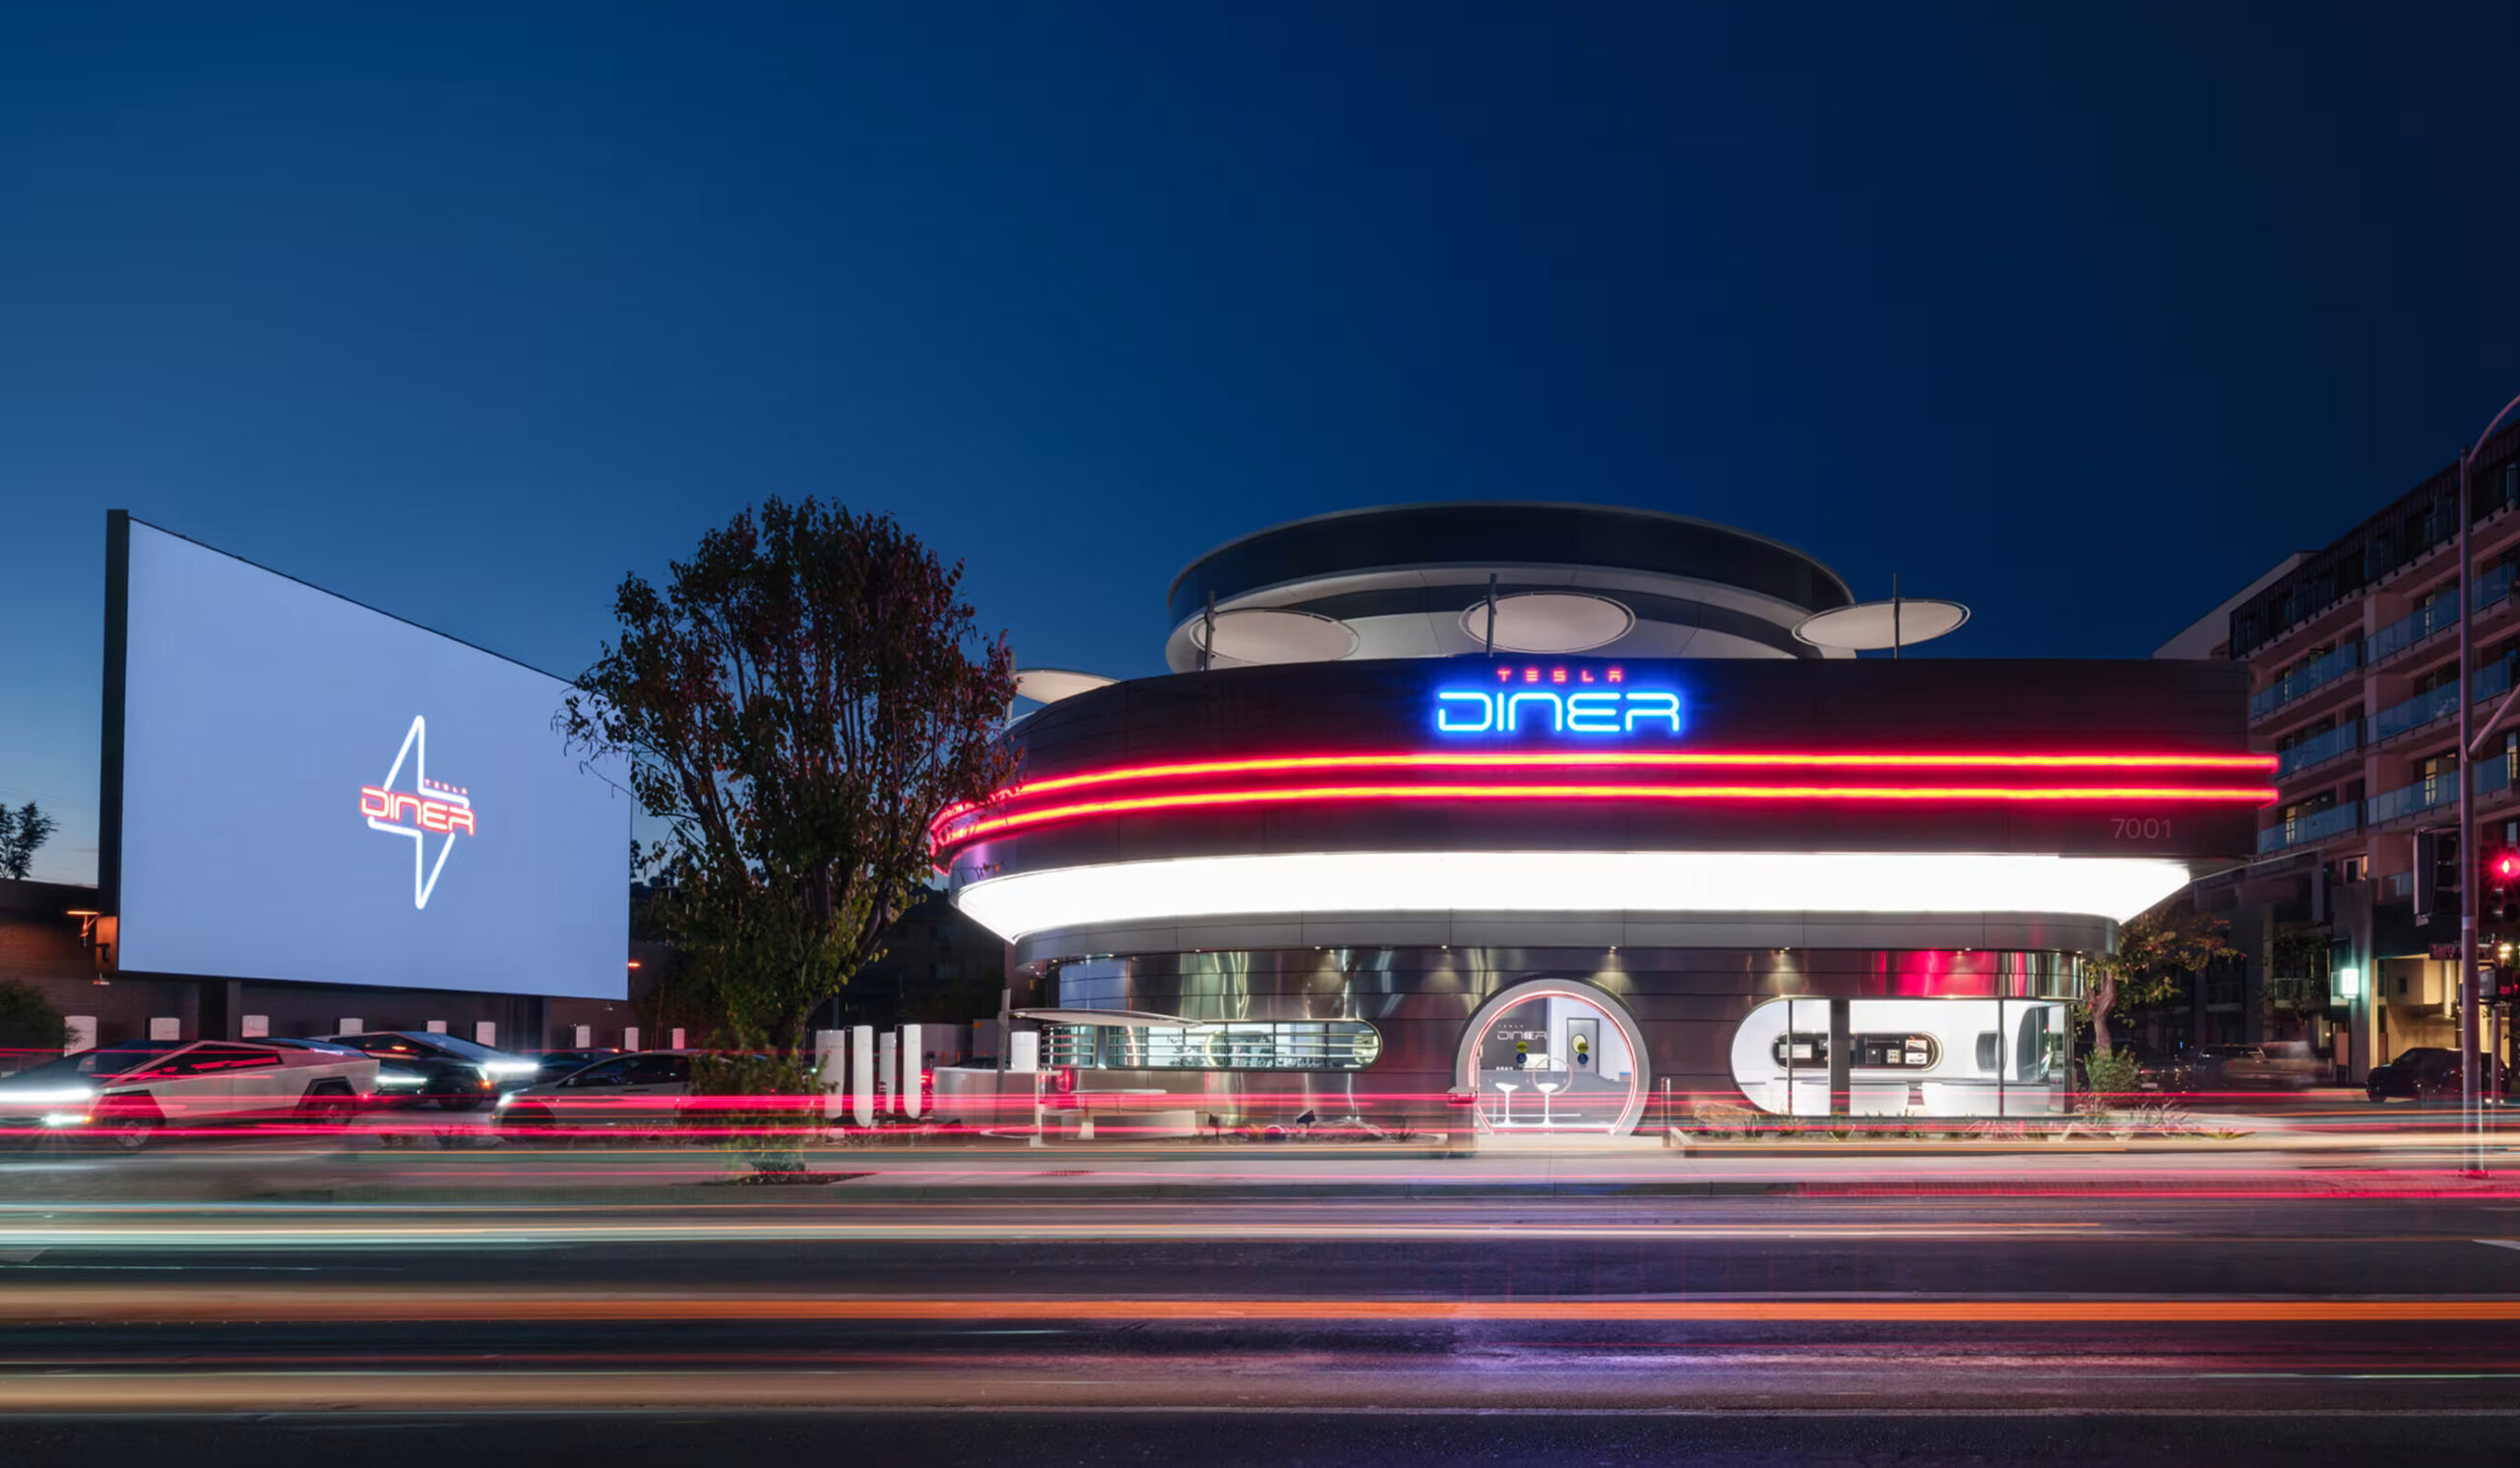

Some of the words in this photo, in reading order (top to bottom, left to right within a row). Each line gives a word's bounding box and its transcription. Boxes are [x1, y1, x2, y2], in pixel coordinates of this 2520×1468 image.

[1497, 670, 1622, 682] TESLA
[1438, 692, 1679, 732] DINER
[361, 787, 474, 836] DINER
[2110, 818, 2172, 839] 7001
